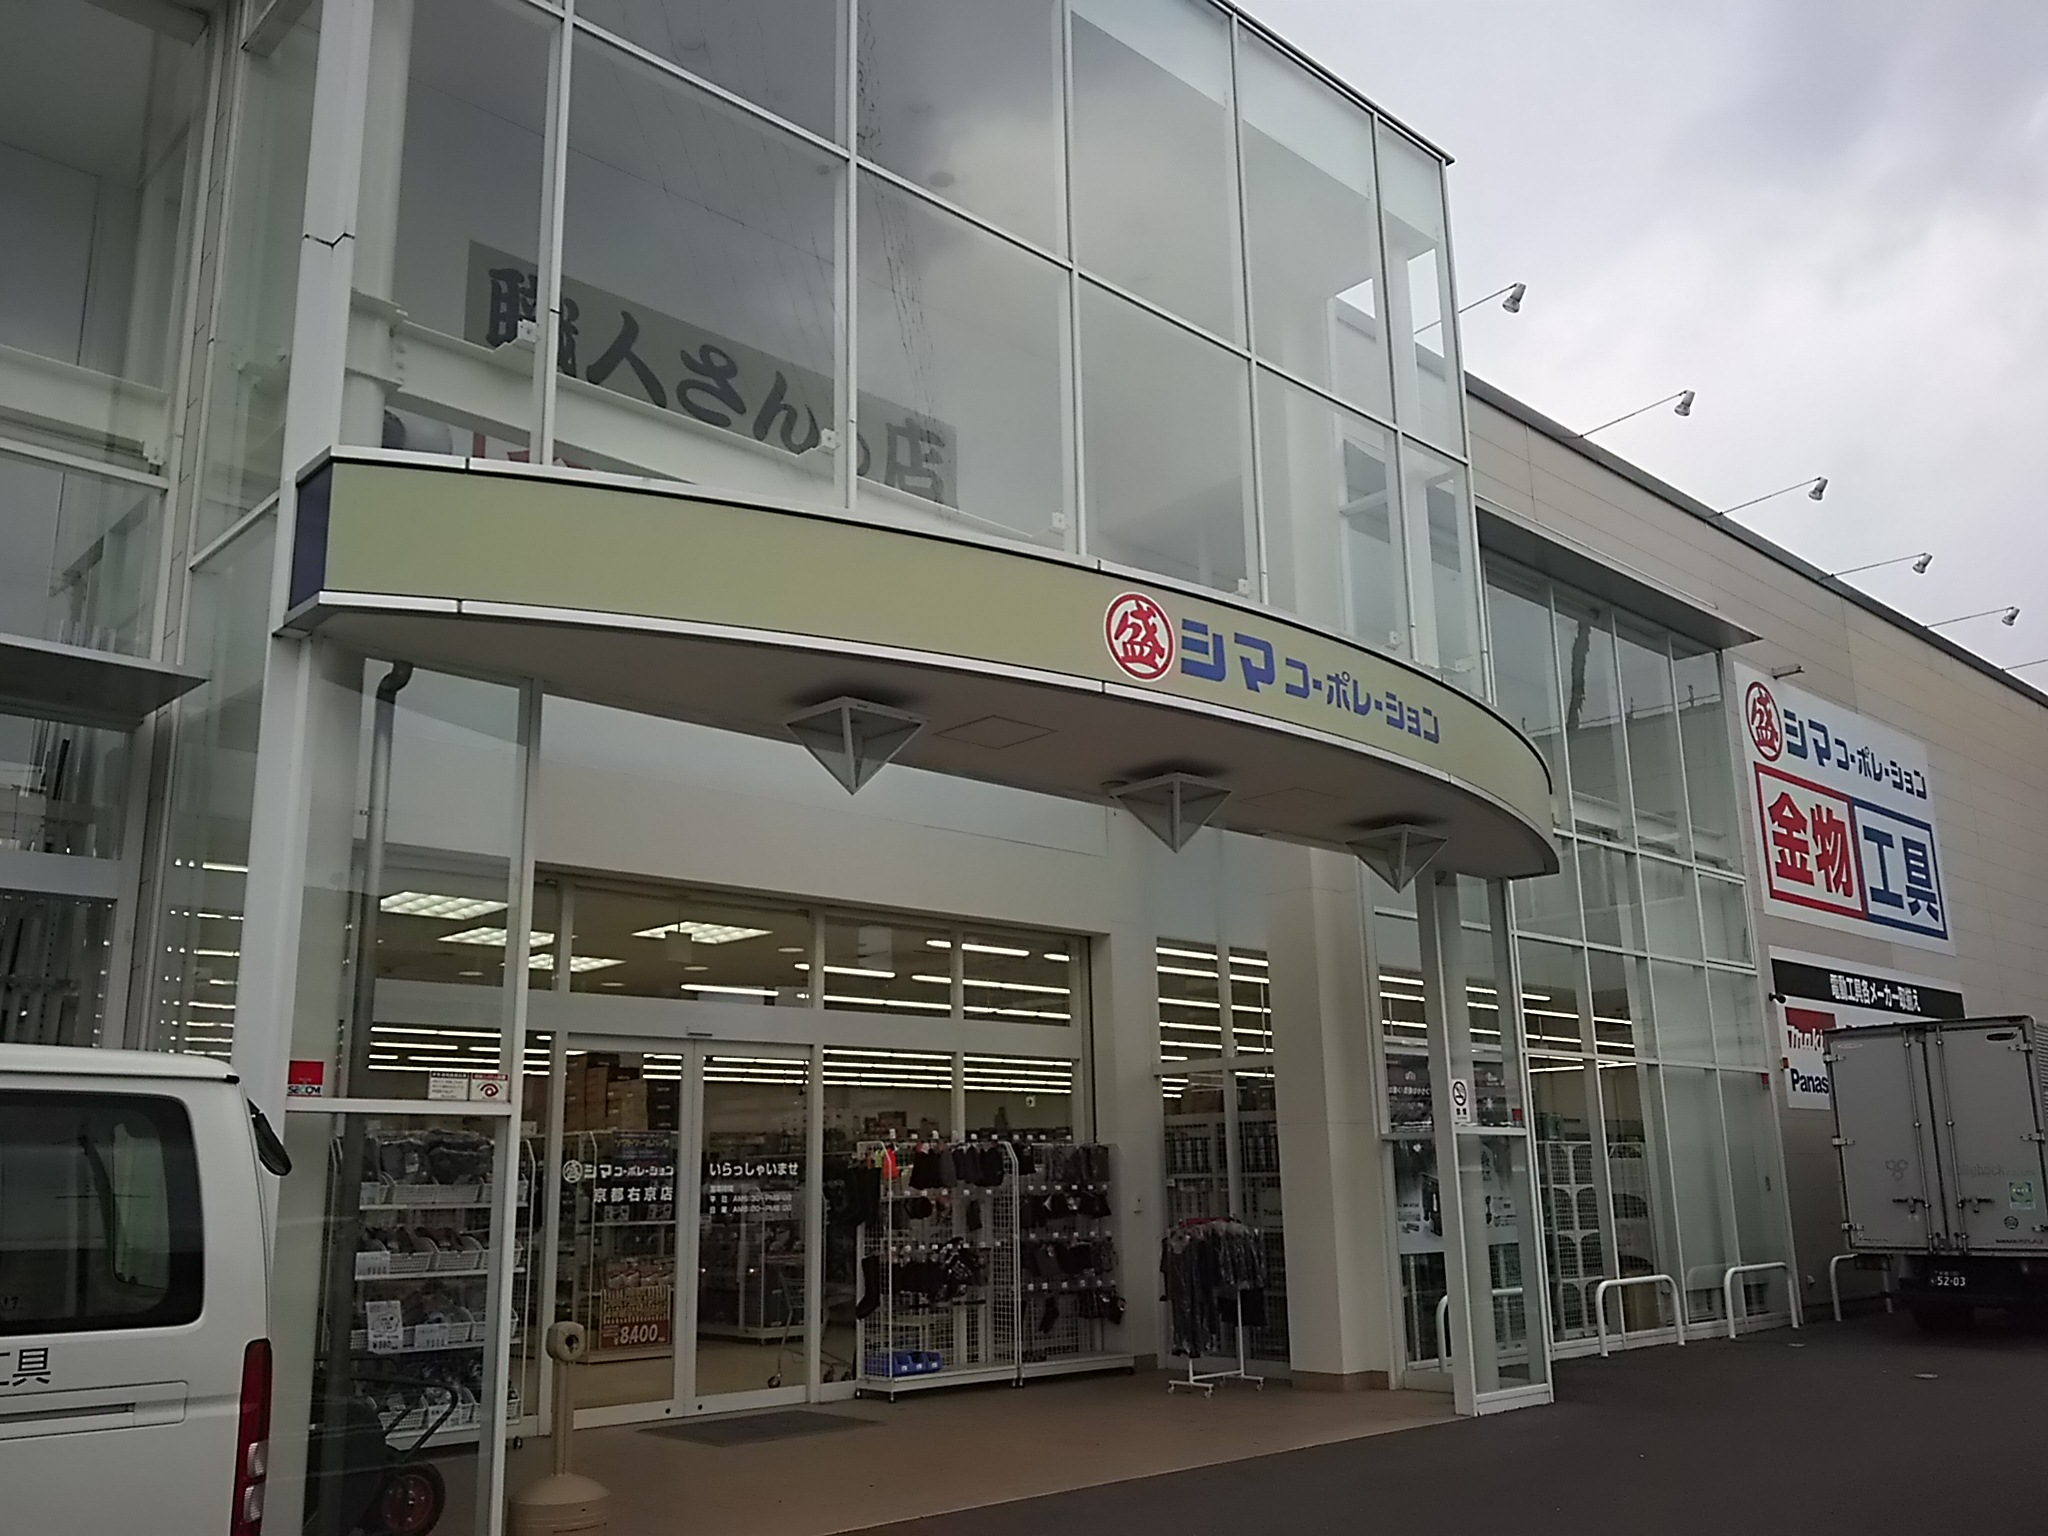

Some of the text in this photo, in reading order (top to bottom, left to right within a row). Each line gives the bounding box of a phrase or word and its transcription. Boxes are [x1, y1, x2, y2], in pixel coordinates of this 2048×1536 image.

[1769, 792, 1940, 922] 金物 工具
[1829, 973, 1921, 1012] 電動工具各メーカー取揃え
[1791, 1068, 1830, 1094] Panas
[709, 1162, 799, 1177] いらっしゃいませ
[594, 1187, 674, 1203] 京都右京店
[1937, 1275, 1966, 1287] 52-03
[0, 1347, 51, 1387] 具
